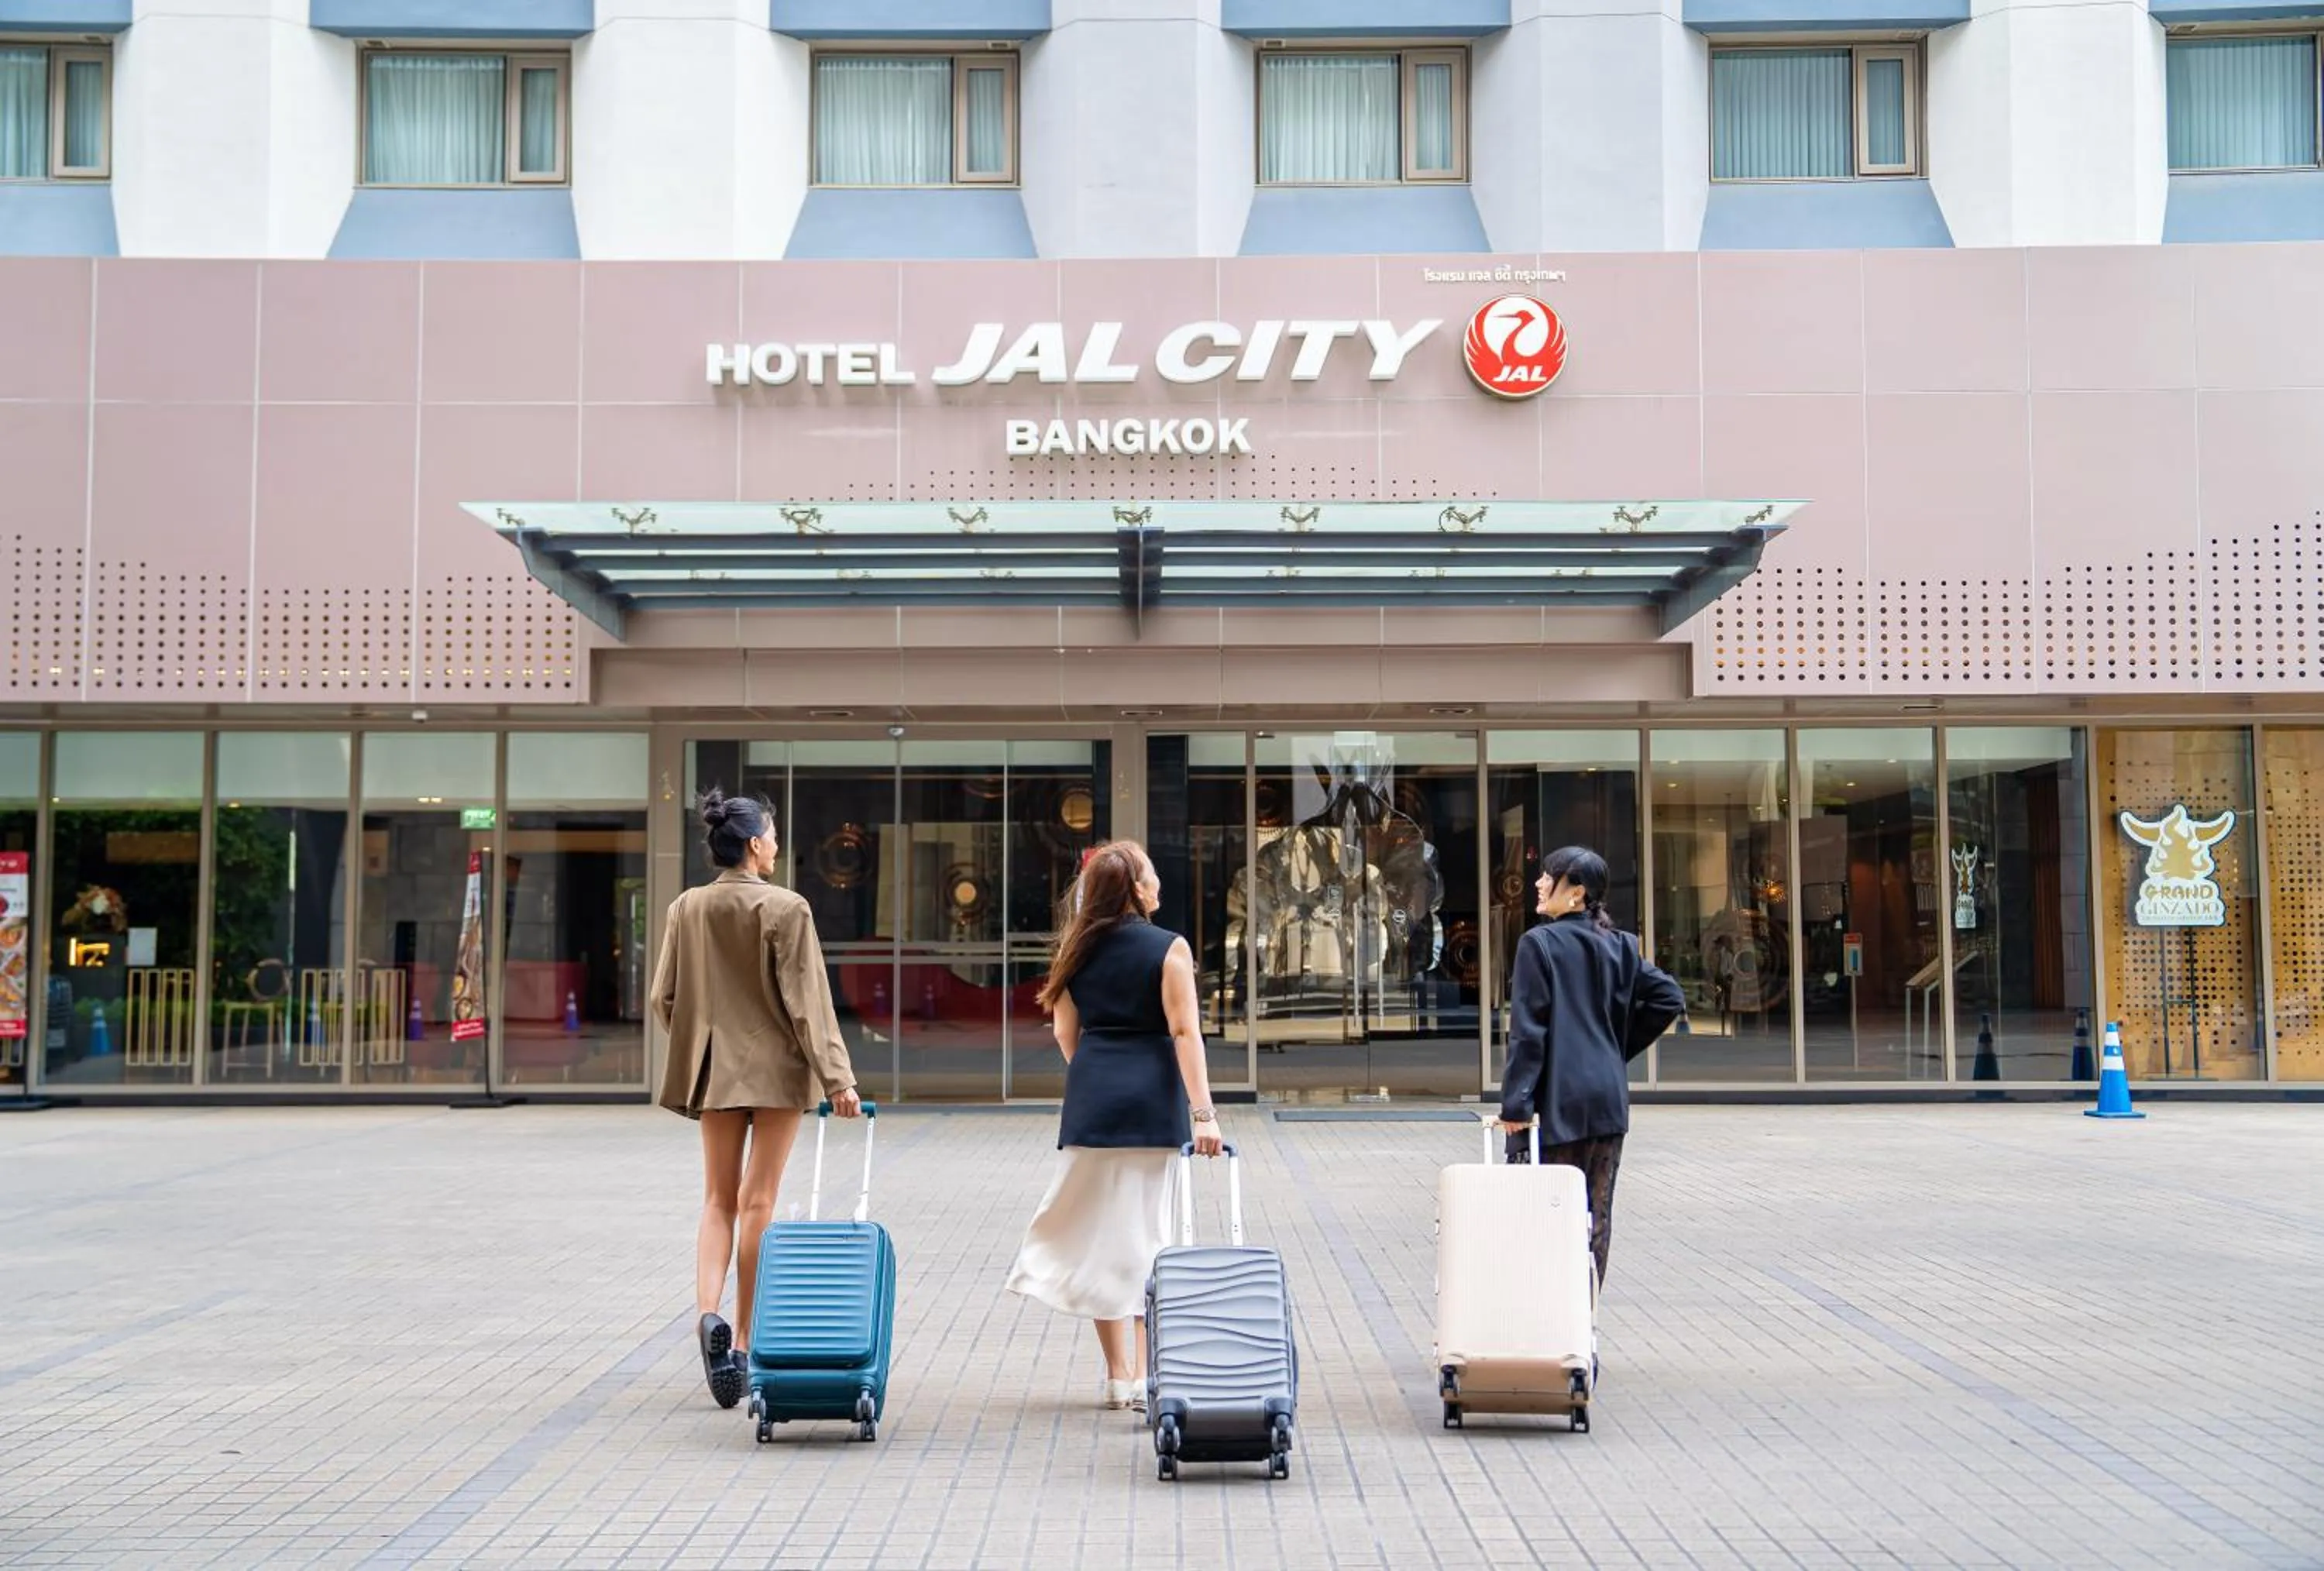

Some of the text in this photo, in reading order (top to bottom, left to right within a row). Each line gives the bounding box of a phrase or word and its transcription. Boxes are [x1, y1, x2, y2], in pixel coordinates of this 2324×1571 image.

[1423, 266, 1465, 282] โรงแรม
[706, 319, 1445, 386] HOTEL JAL CITY
[1492, 364, 1548, 382] JAL
[1006, 418, 1252, 455] BANGKOK
[2144, 884, 2214, 900] GRAND
